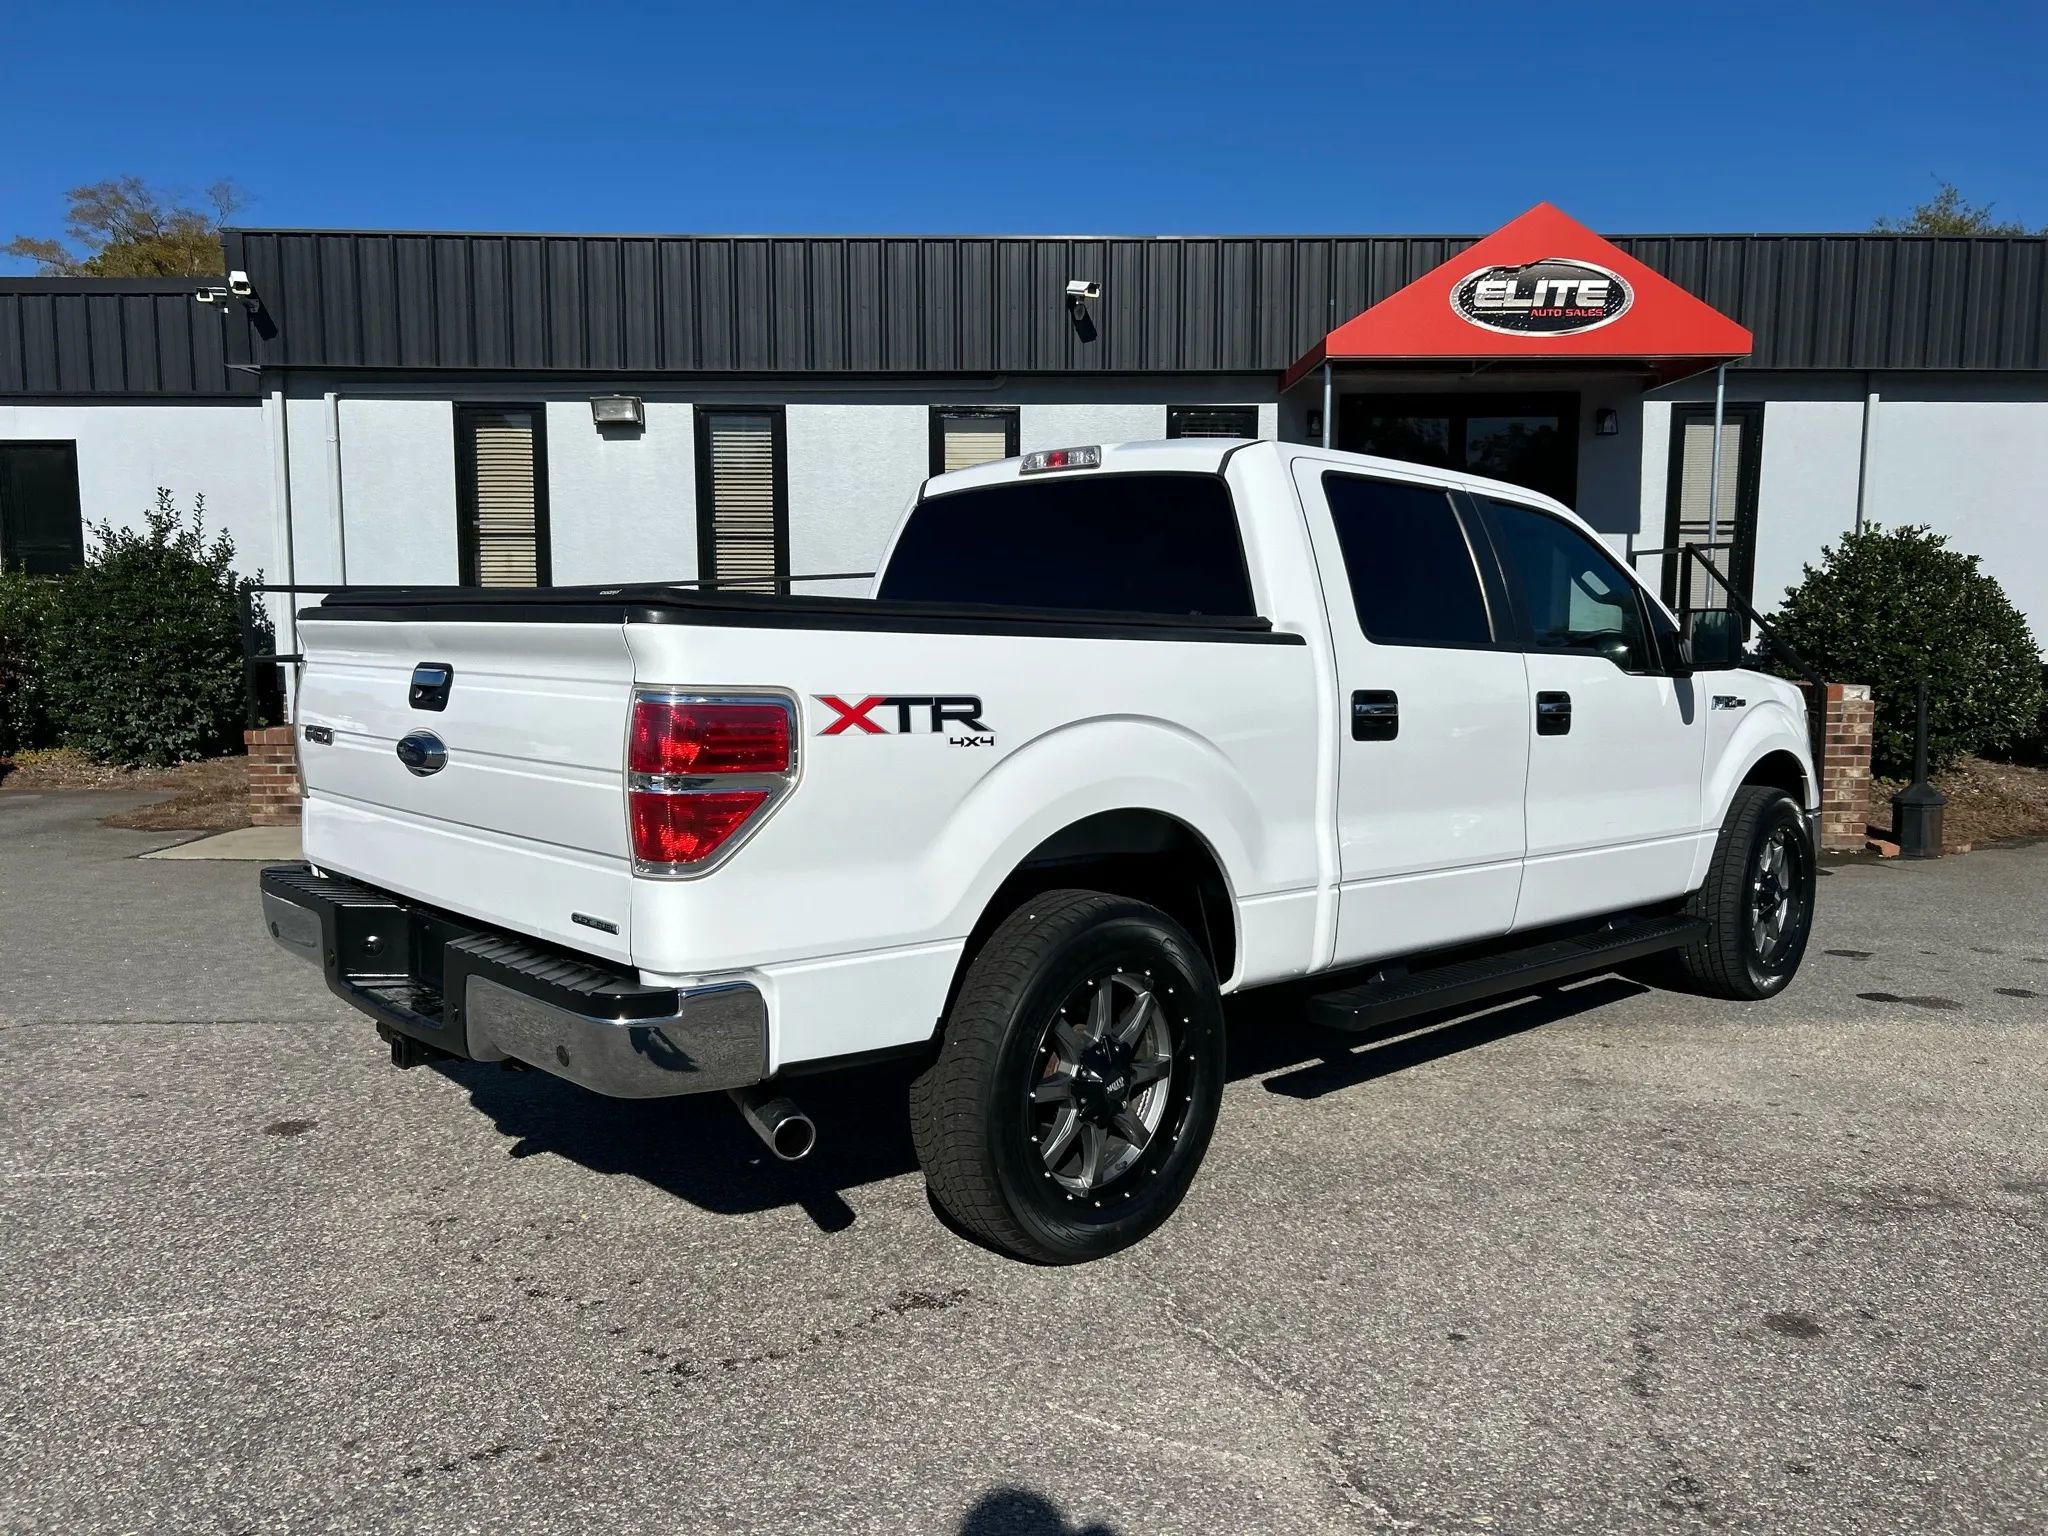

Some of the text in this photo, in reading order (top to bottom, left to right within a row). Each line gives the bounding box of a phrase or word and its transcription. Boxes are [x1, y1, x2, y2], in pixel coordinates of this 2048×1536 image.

[1473, 279, 1610, 307] ELITE
[1530, 308, 1604, 317] AUTO SALES
[811, 694, 996, 735] XTR
